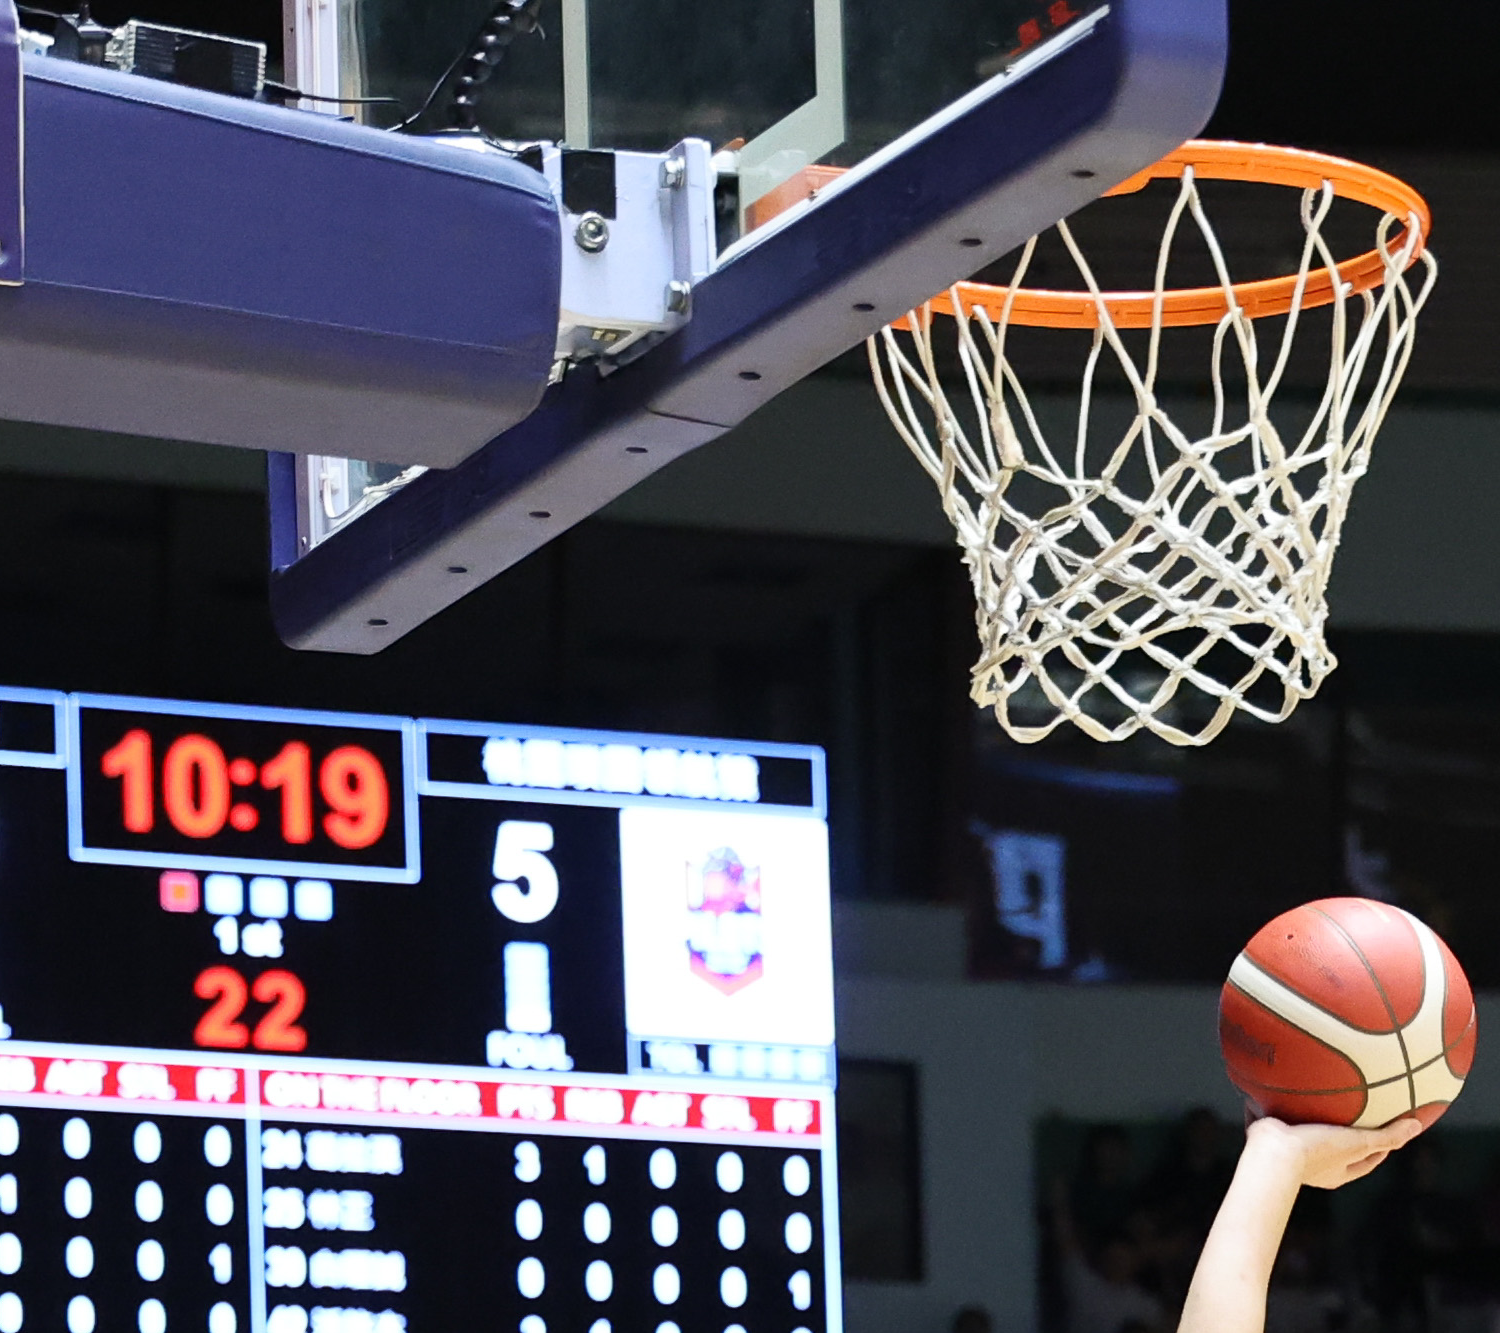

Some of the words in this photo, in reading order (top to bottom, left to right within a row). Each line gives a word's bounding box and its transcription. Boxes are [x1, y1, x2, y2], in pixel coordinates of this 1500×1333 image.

[101, 729, 390, 850] 10:19
[491, 820, 560, 924] 5
[193, 965, 308, 1052] 22
